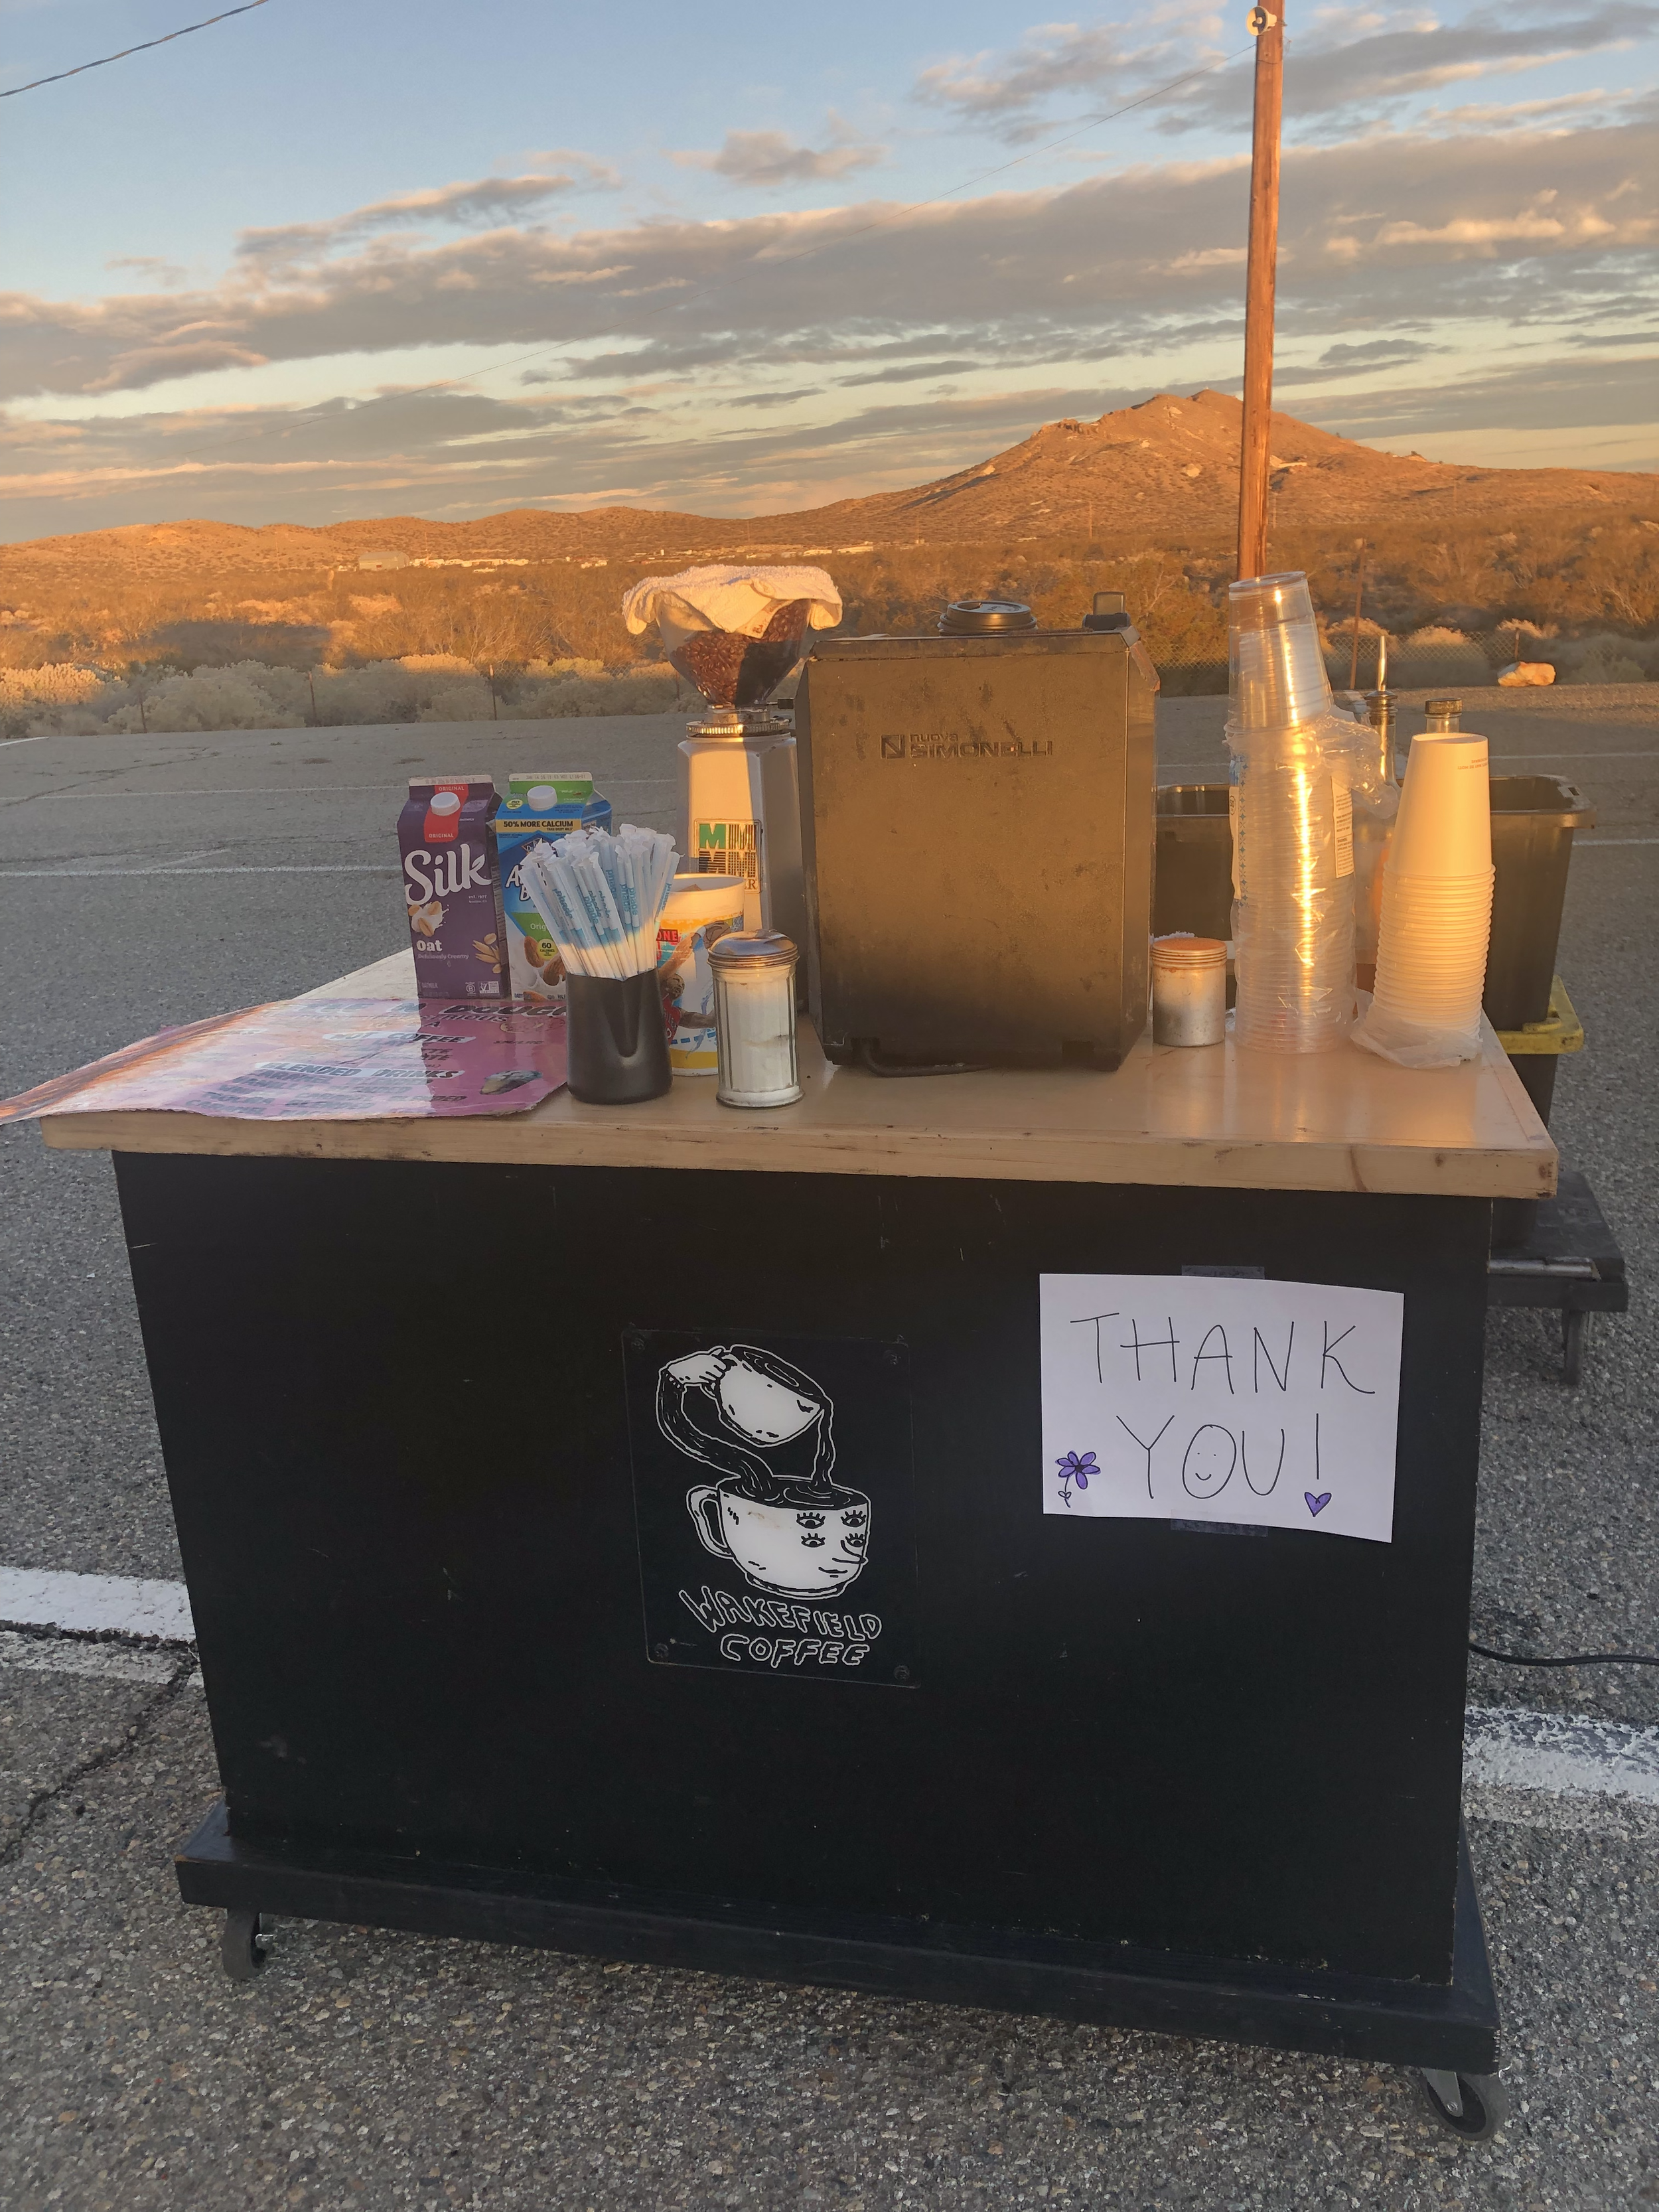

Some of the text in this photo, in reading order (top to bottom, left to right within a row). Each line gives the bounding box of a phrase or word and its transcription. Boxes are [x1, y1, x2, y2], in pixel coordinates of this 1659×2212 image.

[910, 733, 958, 742] nuova
[910, 741, 1053, 758] SIMONELLI
[405, 844, 492, 905] Silk
[584, 895, 600, 925] phade
[628, 887, 638, 916] phade
[416, 940, 443, 952] Oat
[387, 1033, 466, 1043] COFFEE
[261, 1063, 460, 1078] BLENDED DRINKS
[1070, 1312, 1376, 1395] THANK
[1116, 1413, 1321, 1500] YOU!
[678, 1585, 883, 1641] WAKEFIELD
[720, 1633, 870, 1668] COFFEE
